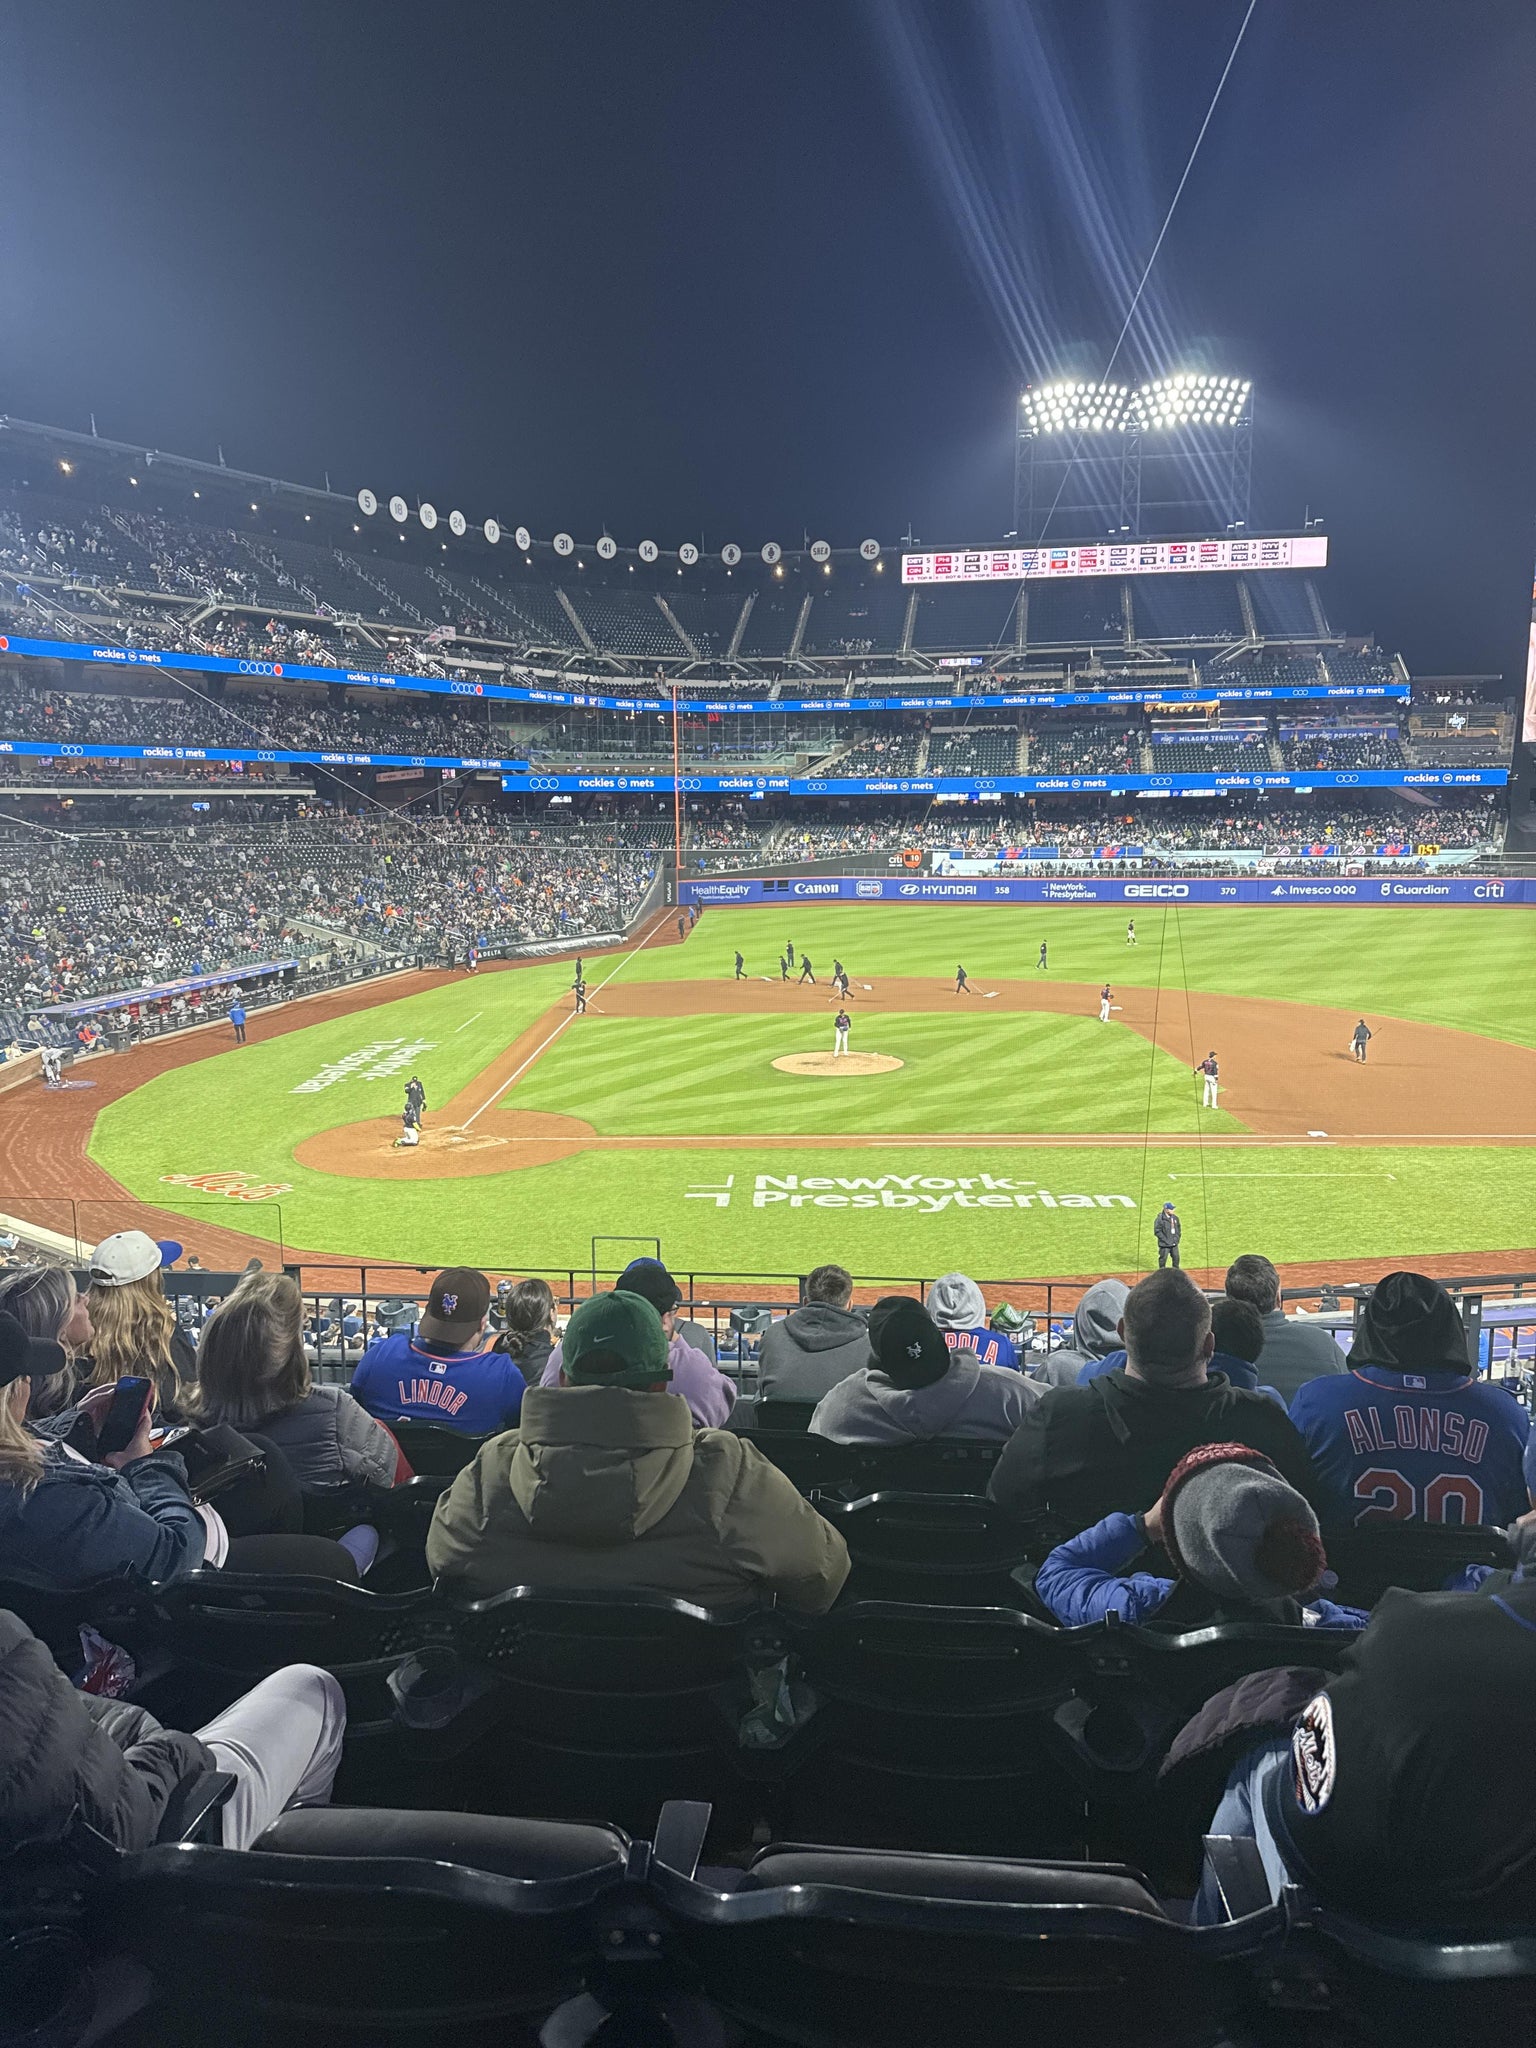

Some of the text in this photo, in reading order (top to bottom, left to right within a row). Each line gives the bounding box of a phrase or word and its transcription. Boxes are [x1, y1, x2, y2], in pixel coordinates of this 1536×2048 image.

[364, 496, 372, 509] 5
[396, 502, 404, 516] 18
[425, 510, 433, 523] 16
[453, 517, 463, 530] 24
[488, 525, 496, 537] 17
[519, 533, 528, 544] 36
[559, 539, 569, 550] 31
[602, 543, 612, 554] 41
[864, 544, 876, 554] 42
[643, 546, 653, 556] 14
[683, 548, 695, 559] 37
[812, 547, 829, 556] SHEA
[93, 646, 125, 659] rockies
[347, 673, 370, 682] rockies
[530, 691, 548, 699] rockies
[143, 747, 206, 759] rockies mets
[322, 753, 371, 763] rockies mets
[462, 759, 481, 768] rockies
[579, 778, 614, 787] rockies
[719, 778, 787, 787] rockies met
[1216, 776, 1250, 784] rockies
[1404, 774, 1439, 782] rockies
[866, 782, 897, 790] rockies
[1036, 780, 1069, 788] rockies
[910, 854, 919, 862] 10
[691, 885, 751, 897] HealthEquity
[794, 883, 839, 895] Canon
[922, 885, 977, 895] HYUNDAI
[994, 886, 1010, 895] 358
[1050, 883, 1086, 891] NewYork-
[1124, 884, 1189, 898] GEICO
[1221, 887, 1237, 896] 370
[1289, 885, 1357, 896] Invesco QQQ
[1394, 885, 1449, 895] Guardian
[1474, 881, 1504, 898] citi
[1050, 890, 1097, 899] Presbyterian
[483, 949, 502, 958] DELTA
[754, 1174, 1037, 1191] NewYork-
[752, 1190, 1138, 1213] Presbyterian
[398, 1378, 468, 1417] LINDOR
[1344, 1405, 1490, 1465] ALONSO
[1353, 1466, 1484, 1528] 20
